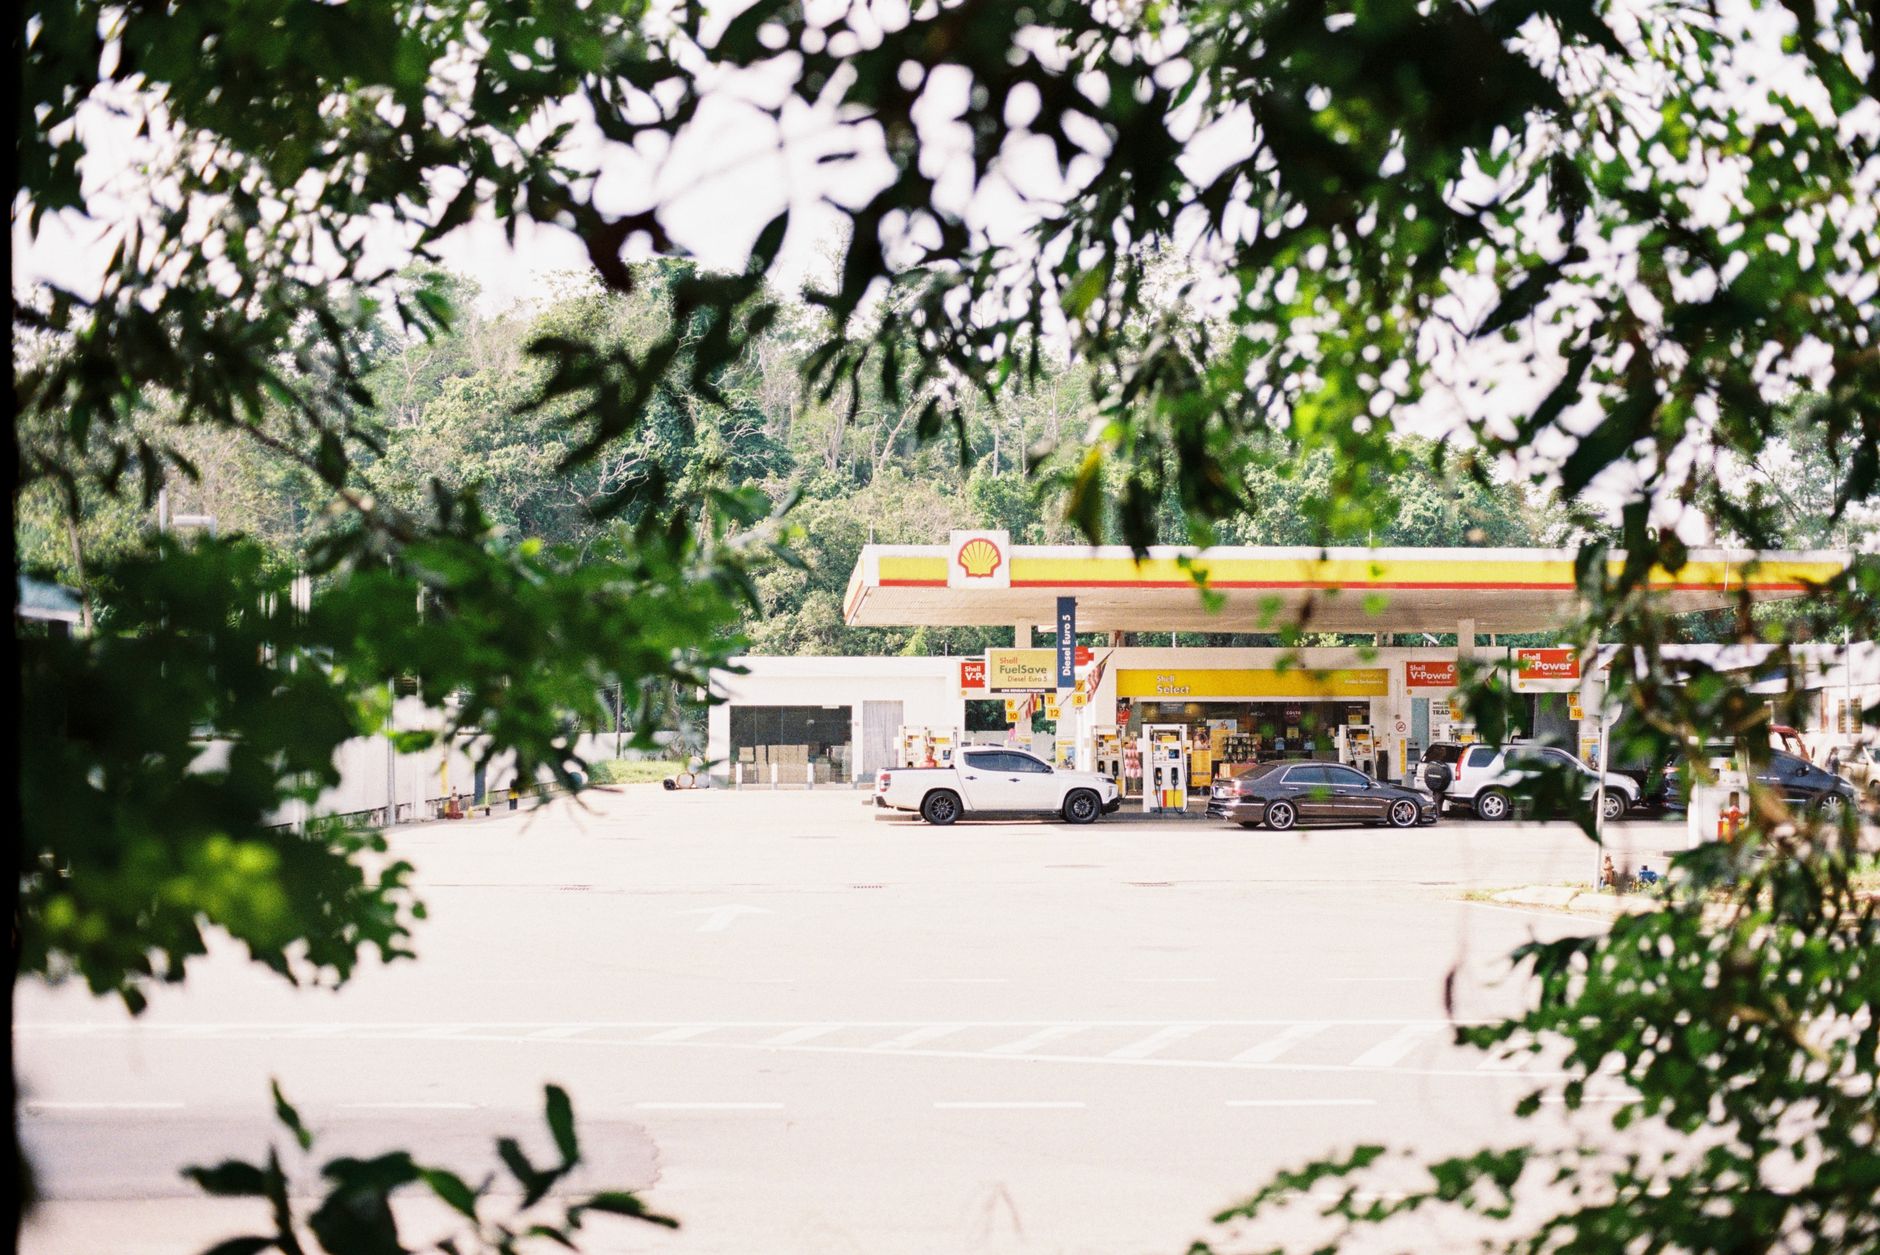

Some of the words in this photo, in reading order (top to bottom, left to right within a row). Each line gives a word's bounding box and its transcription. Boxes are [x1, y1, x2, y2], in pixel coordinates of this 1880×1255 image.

[1062, 623, 1071, 645] Euro
[1062, 647, 1071, 676] Diesel
[999, 665, 1047, 674] FuelSave
[1410, 671, 1452, 680] V-Power
[1156, 685, 1190, 694] Select
[1009, 712, 1017, 720] 10
[1050, 709, 1059, 717] 12
